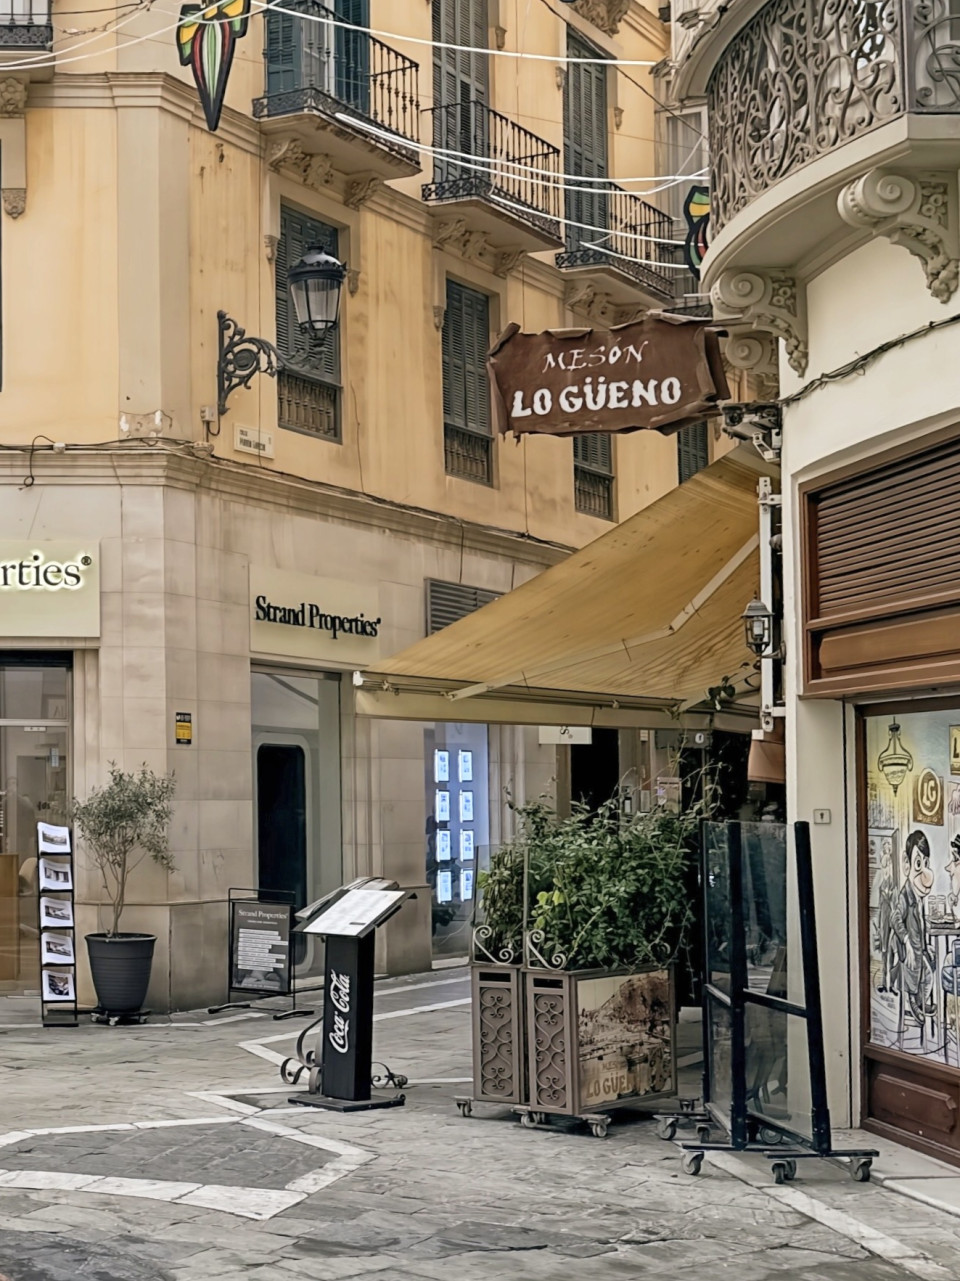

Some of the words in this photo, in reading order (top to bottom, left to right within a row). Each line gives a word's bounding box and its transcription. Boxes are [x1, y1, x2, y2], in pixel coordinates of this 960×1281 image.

[542, 337, 648, 373] MESÓN
[511, 388, 553, 418] LO
[559, 376, 681, 413] GÜENO
[255, 595, 306, 626] Strand
[587, 1079, 600, 1098] LO
